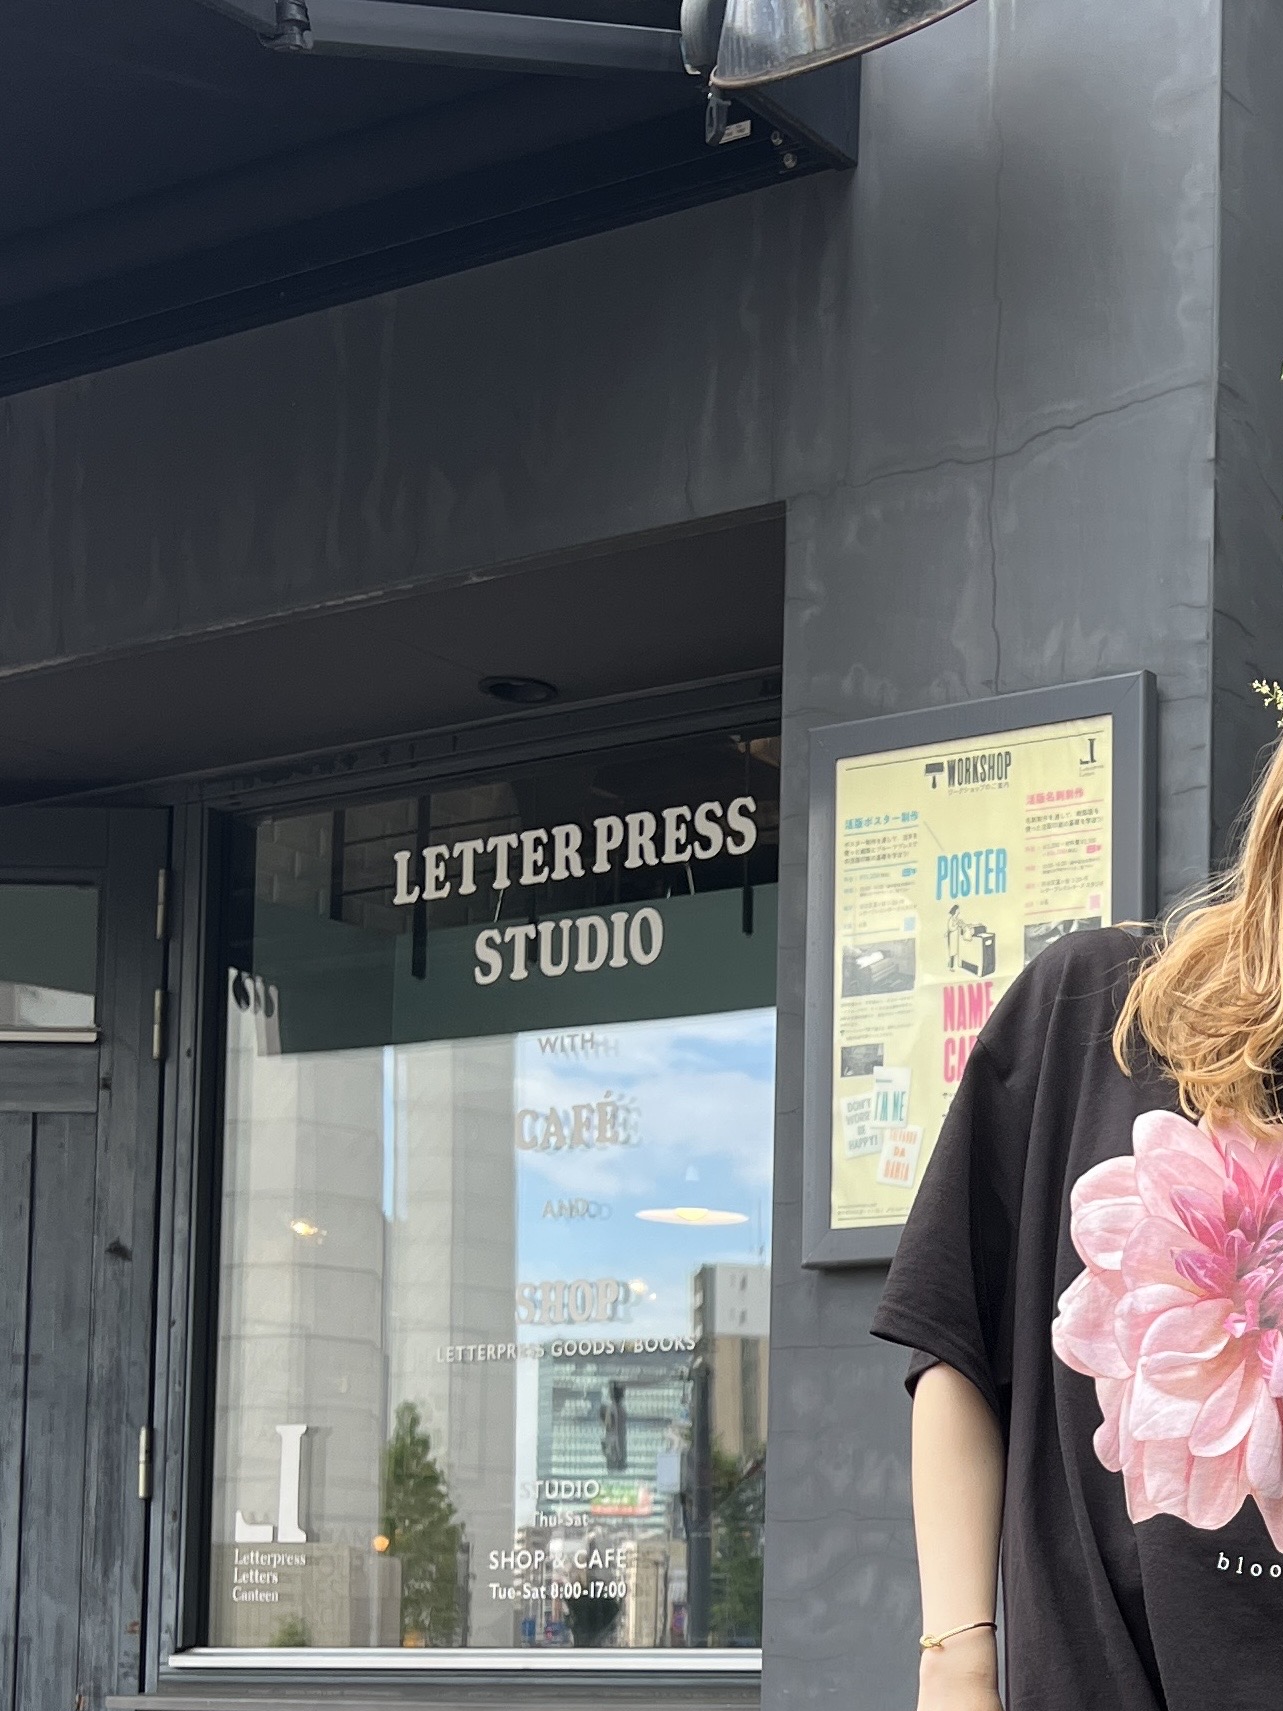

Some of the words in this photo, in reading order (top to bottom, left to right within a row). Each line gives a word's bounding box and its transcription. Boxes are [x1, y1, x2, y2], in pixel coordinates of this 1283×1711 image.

[947, 751, 1012, 788] WORKSHOP
[936, 847, 1007, 901] POSTER
[473, 906, 665, 986] STUDIO
[943, 981, 994, 1032] NAME
[538, 1031, 595, 1054] WITH
[943, 1034, 978, 1084] CA
[515, 1089, 619, 1151] CAFÉ
[542, 1197, 590, 1219] AND
[515, 1277, 619, 1326] SHOP
[551, 1339, 615, 1358] GOODS
[633, 1335, 697, 1354] BOOKS
[519, 1479, 601, 1500] STUDIO
[234, 1548, 307, 1569] Letterpress
[488, 1549, 546, 1571] SHOP
[233, 1567, 279, 1584] Letters
[232, 1586, 279, 1602] Canteen
[488, 1582, 547, 1601] Tue-Sat
[550, 1581, 627, 1600] 8:00-17:00
